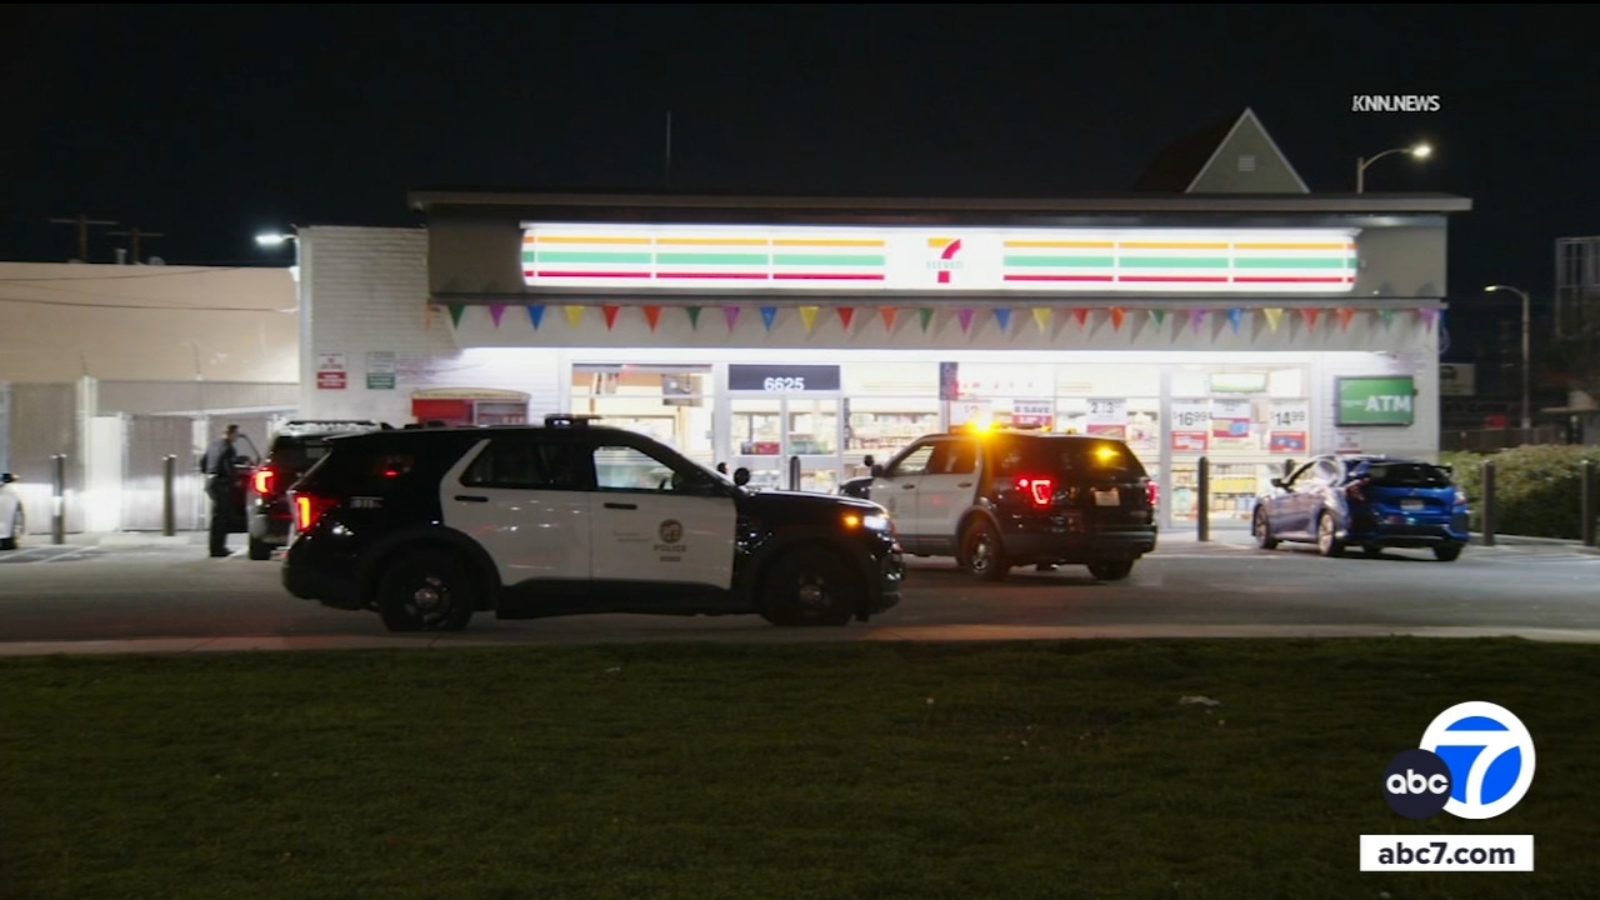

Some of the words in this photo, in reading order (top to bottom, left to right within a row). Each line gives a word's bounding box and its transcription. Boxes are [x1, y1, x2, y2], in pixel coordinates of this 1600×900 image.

[926, 238, 962, 283] 7
[763, 377, 805, 391] 6625
[1364, 395, 1412, 411] ATM
[653, 544, 687, 552] POLICE
